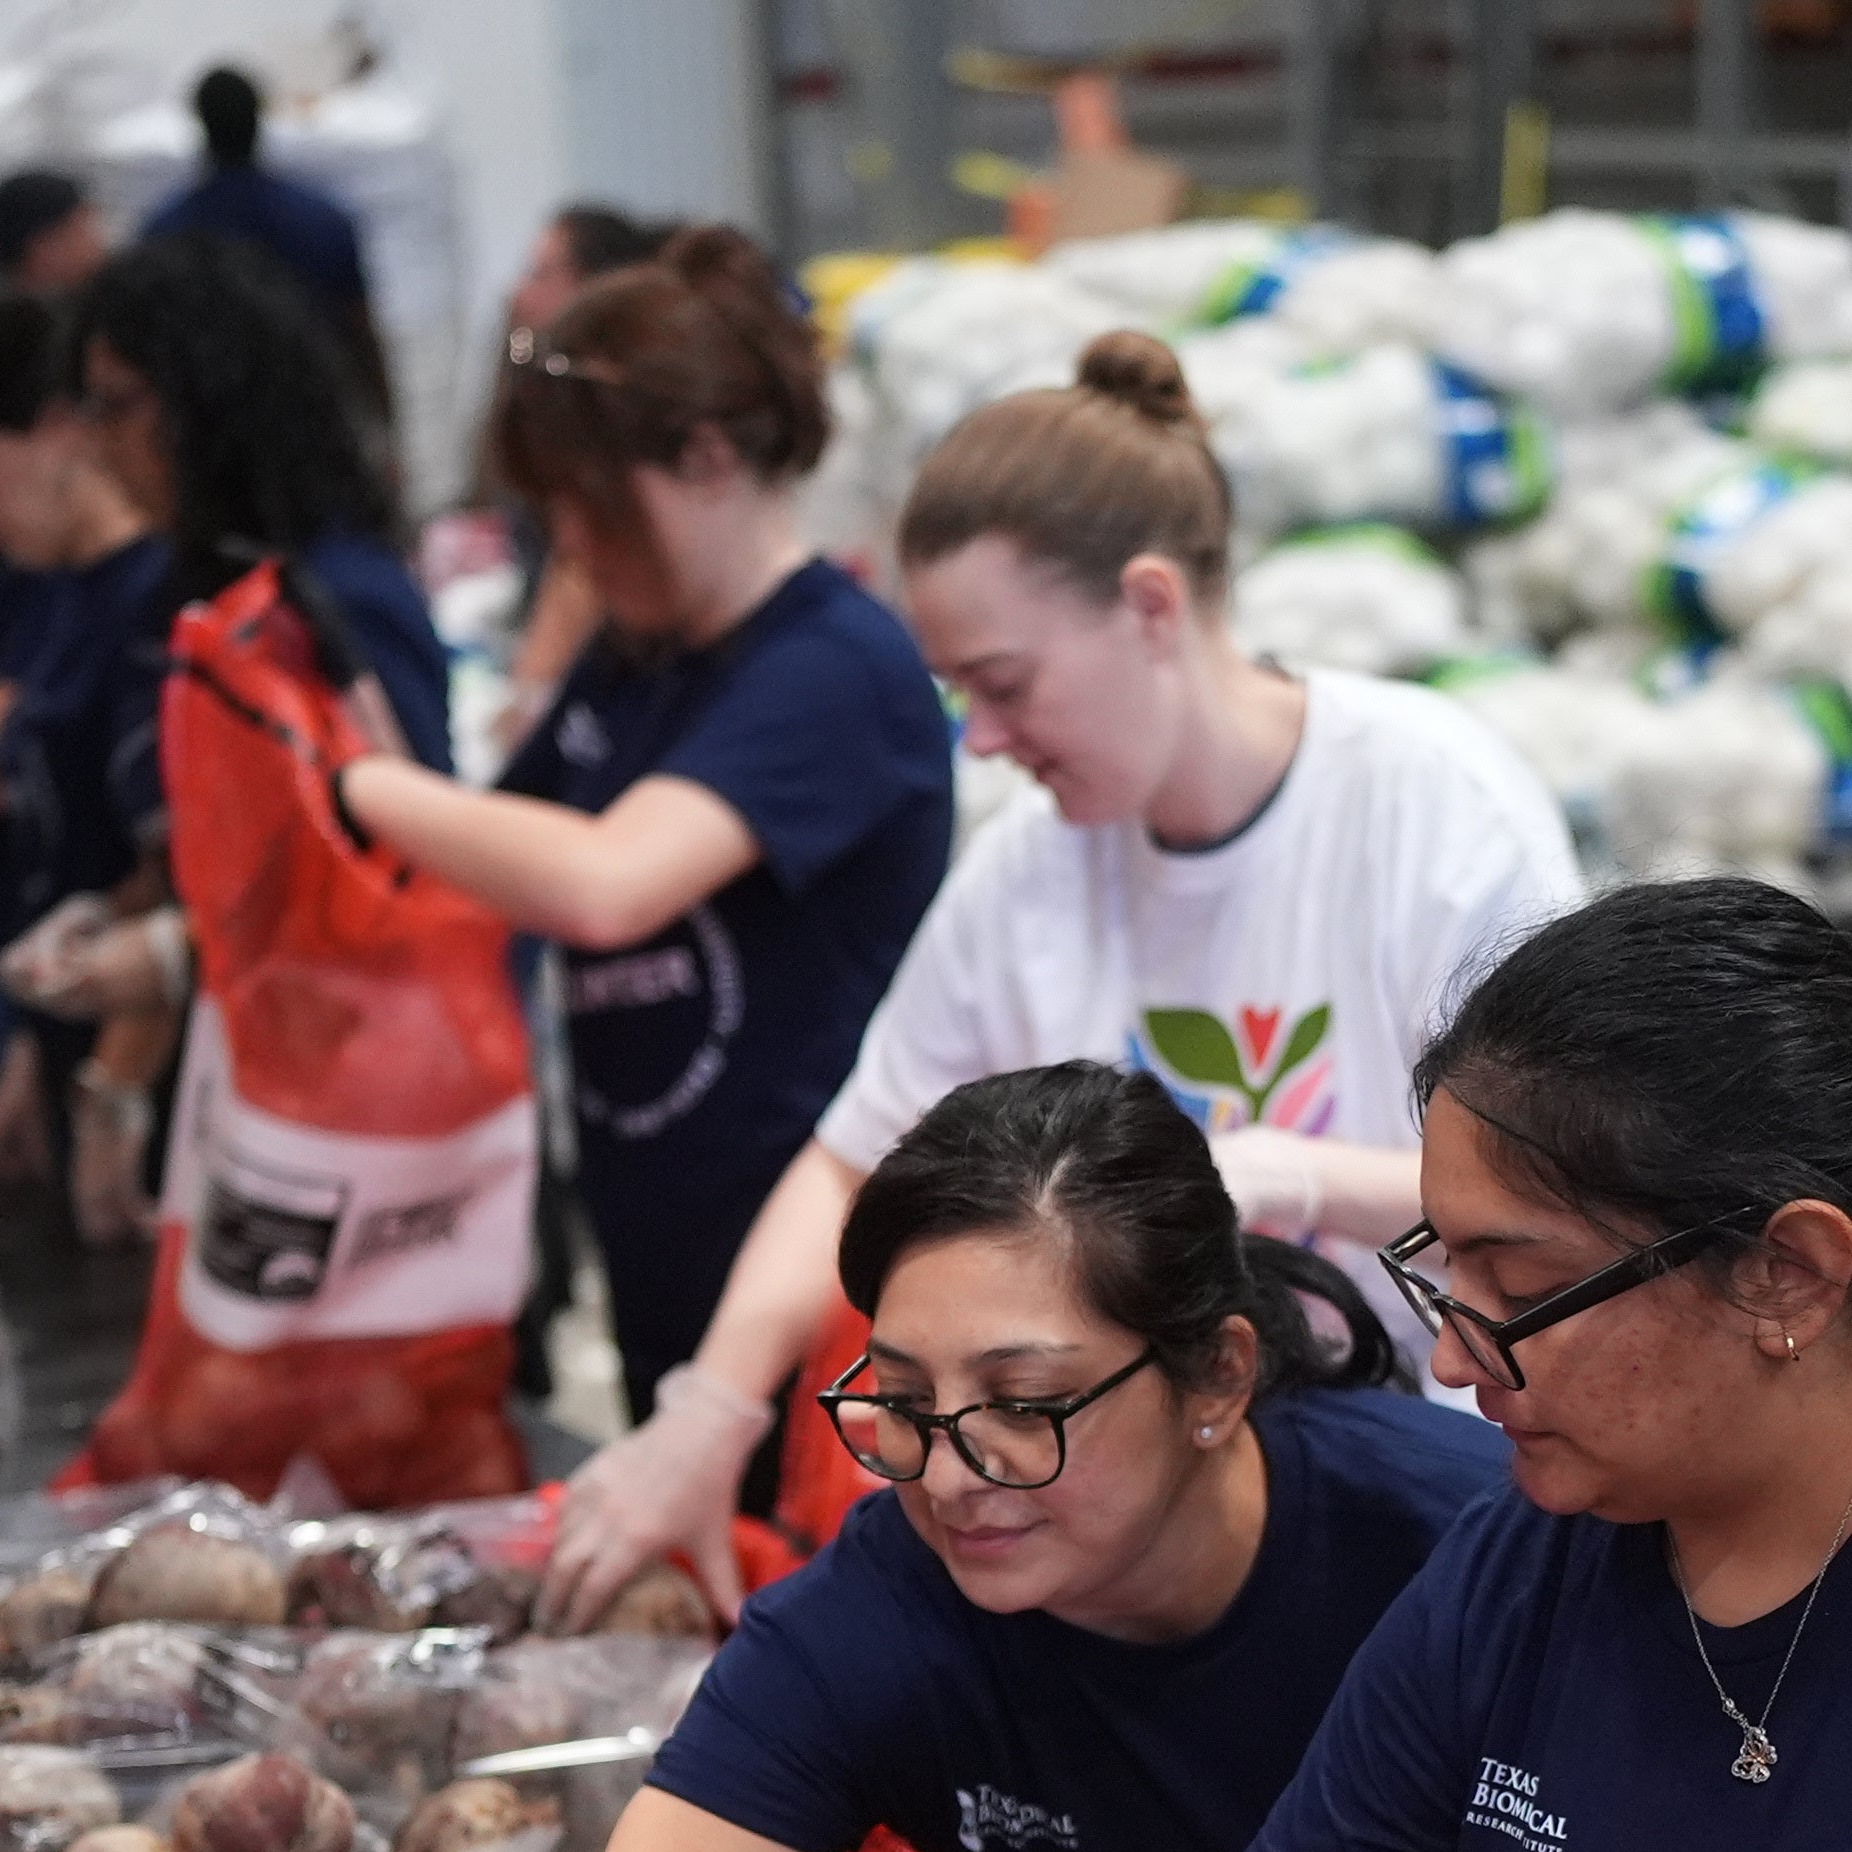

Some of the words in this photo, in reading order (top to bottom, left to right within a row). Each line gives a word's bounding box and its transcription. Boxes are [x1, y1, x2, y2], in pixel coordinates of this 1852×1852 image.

[1480, 1757, 1540, 1797] TEXAS
[1465, 1811, 1525, 1841] RESEARCH
[1471, 1782, 1568, 1840] BIOMICAL
